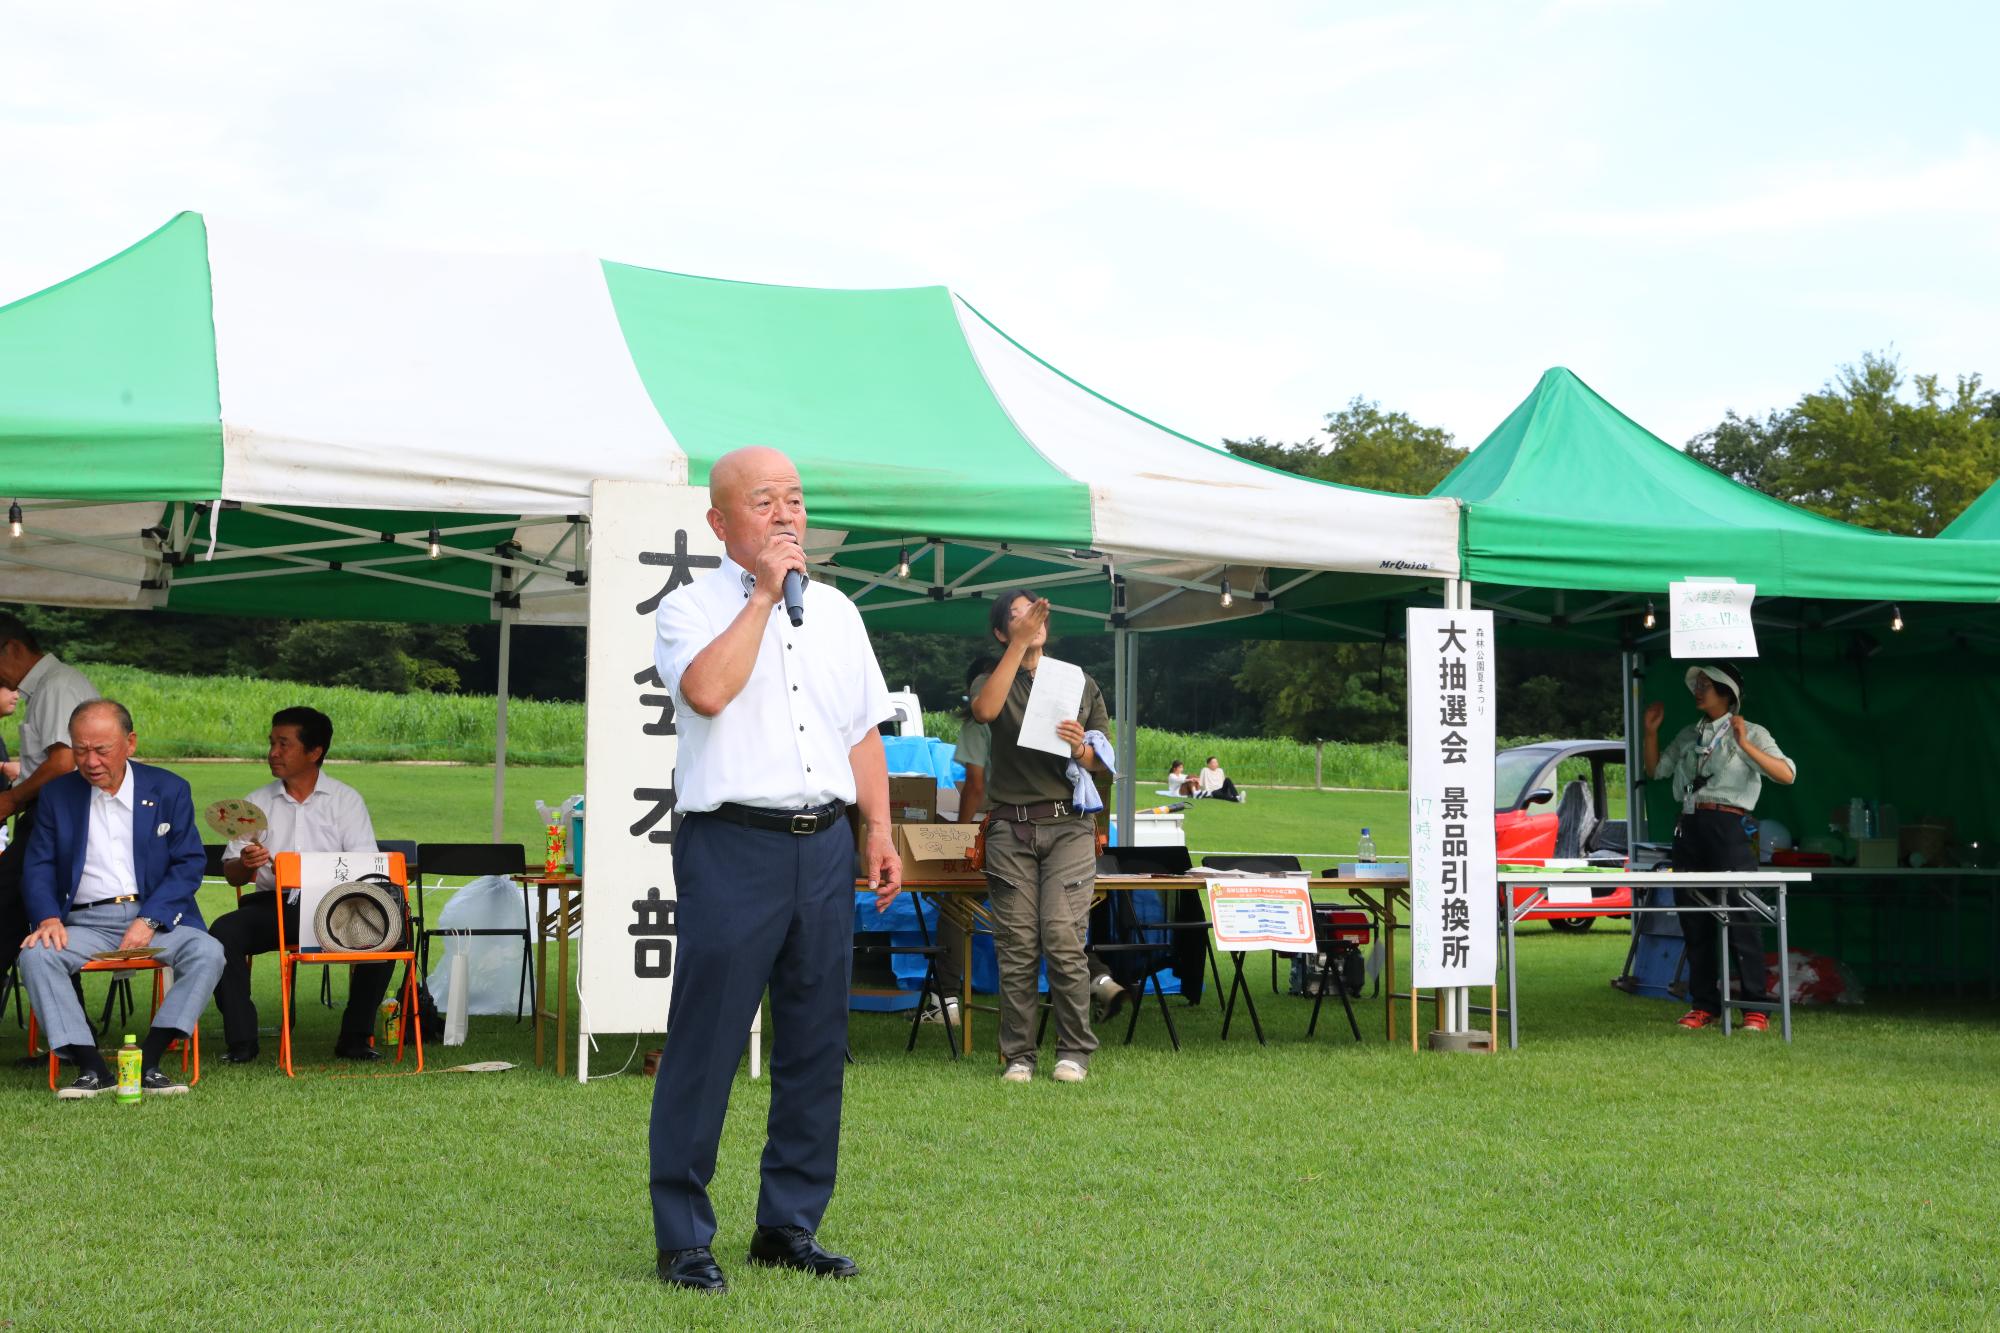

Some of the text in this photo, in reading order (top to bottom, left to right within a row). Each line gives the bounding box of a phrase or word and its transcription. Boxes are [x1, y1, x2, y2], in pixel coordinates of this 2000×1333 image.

[1378, 560, 1429, 570] MrQuick
[1476, 628, 1486, 716] 森林公園夏まつり
[1437, 620, 1470, 969] 大抽選会 景品引換所
[334, 856, 349, 882] 大塚
